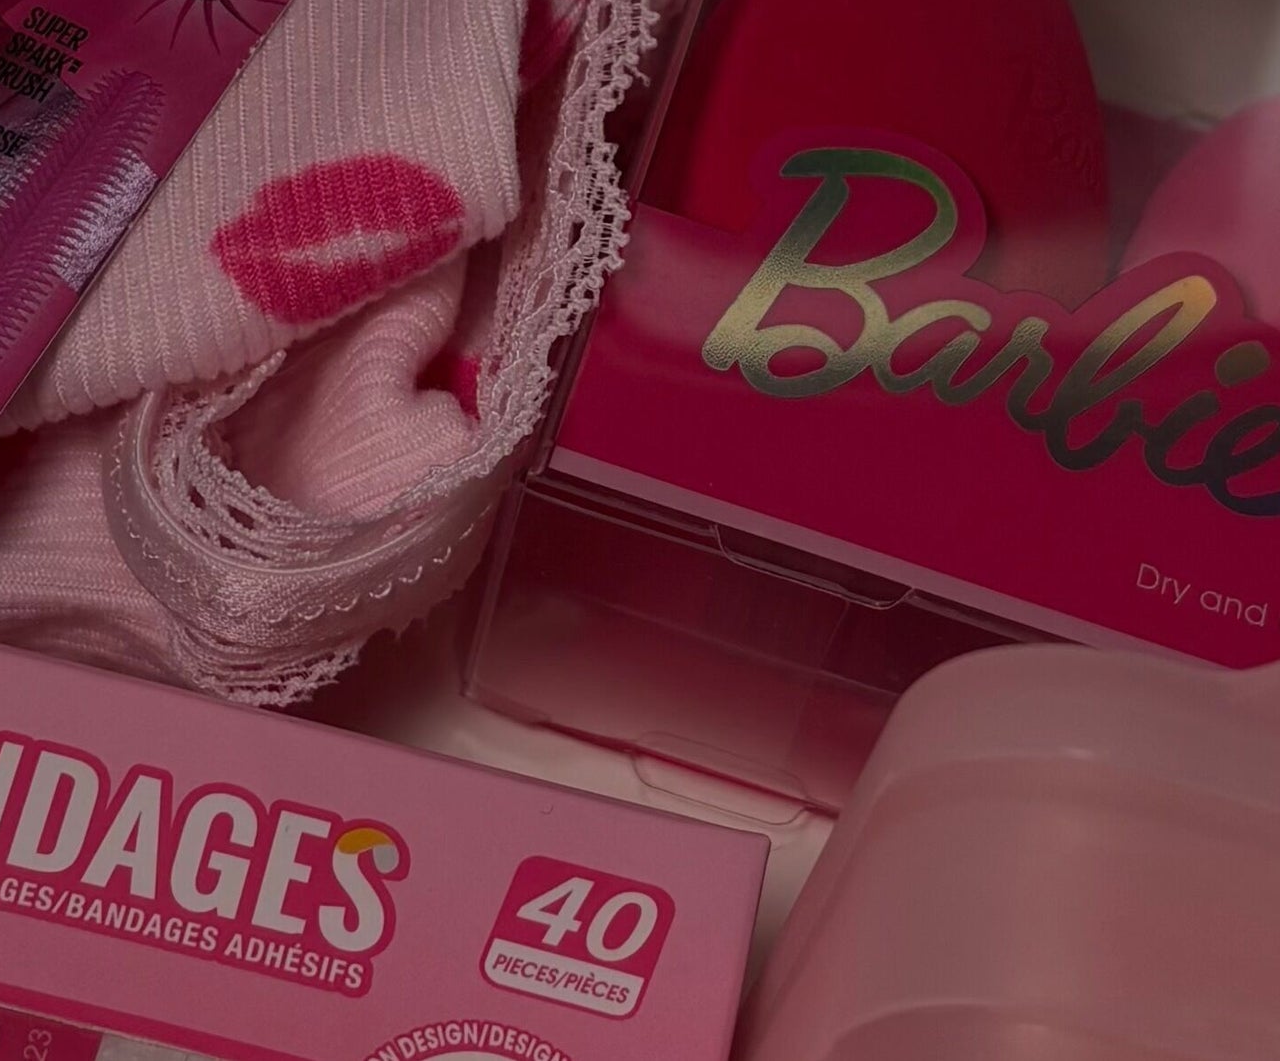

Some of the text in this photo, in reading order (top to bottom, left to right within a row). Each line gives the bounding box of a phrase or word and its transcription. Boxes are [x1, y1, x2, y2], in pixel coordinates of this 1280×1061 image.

[23, 6, 89, 50] SUPER
[1134, 562, 1192, 605] Dry
[1197, 586, 1270, 629] and
[515, 875, 659, 964] 40
[222, 924, 367, 992] ADHÉSIFS
[491, 951, 631, 1007] PIECES/PIÈCES
